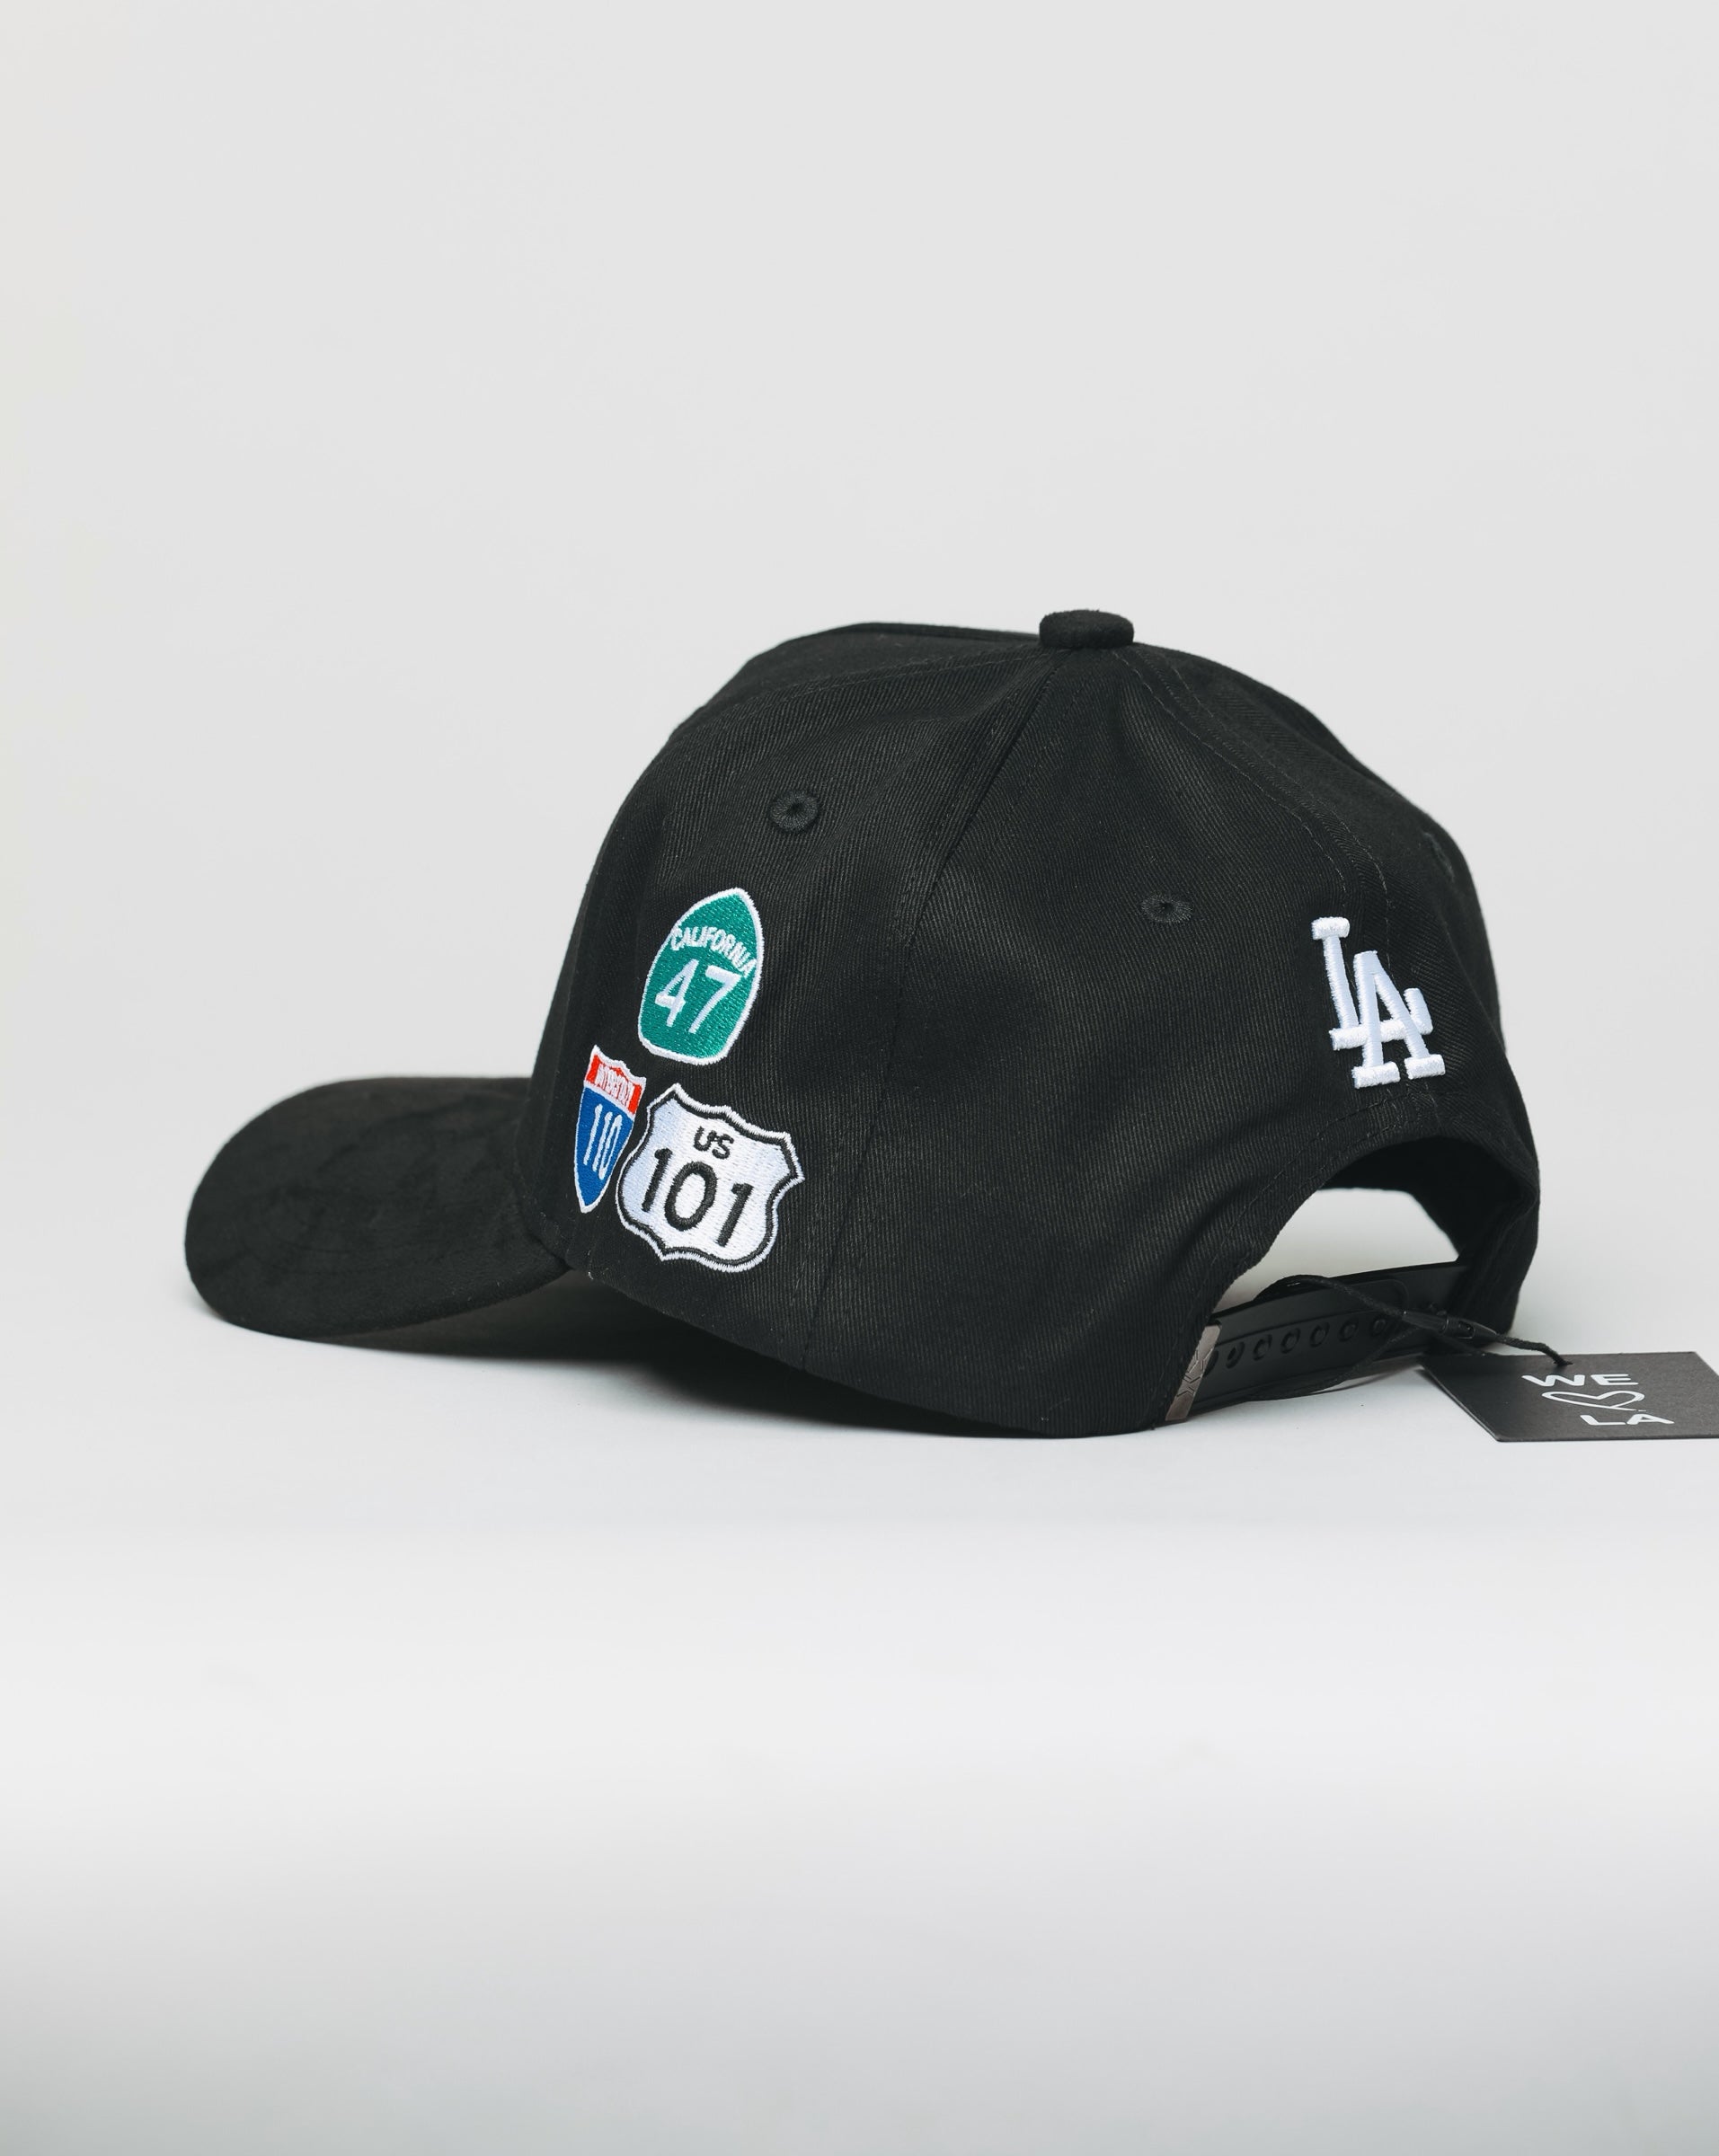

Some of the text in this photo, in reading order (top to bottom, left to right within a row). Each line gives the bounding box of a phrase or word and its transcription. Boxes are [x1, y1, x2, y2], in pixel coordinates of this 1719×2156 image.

[670, 926, 757, 978] CALIFORNIA
[655, 959, 742, 1034] 47
[1311, 916, 1446, 1090] LA
[583, 1103, 623, 1180] 110
[694, 1126, 735, 1160] US
[642, 1147, 754, 1248] 101
[1521, 1374, 1639, 1387] WE
[1580, 1413, 1675, 1427] LA
